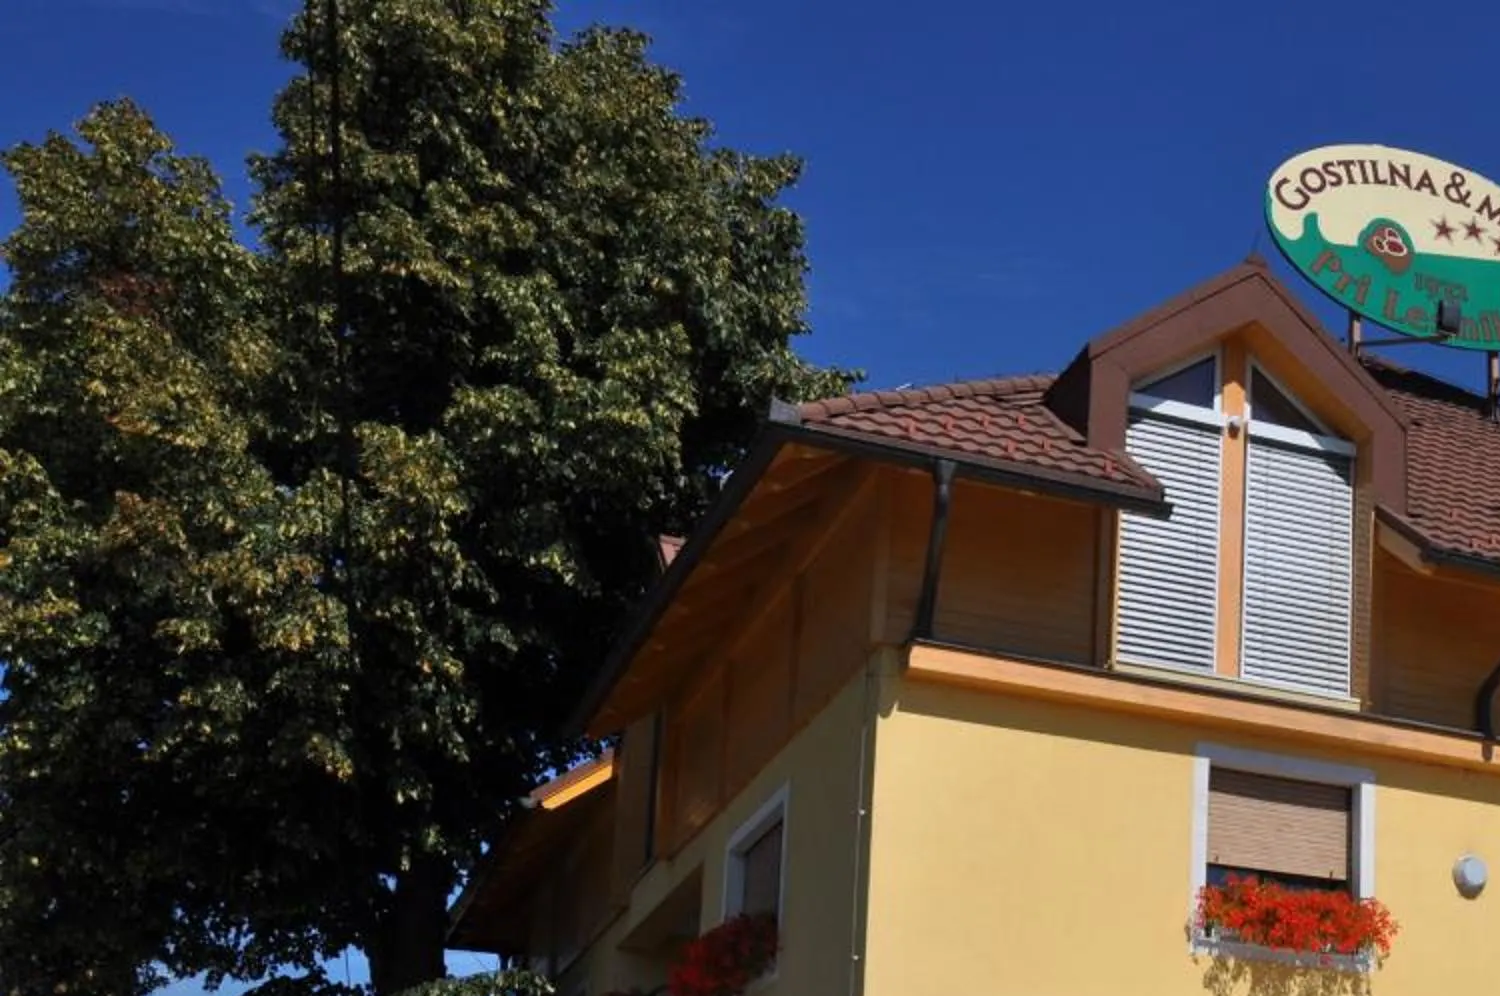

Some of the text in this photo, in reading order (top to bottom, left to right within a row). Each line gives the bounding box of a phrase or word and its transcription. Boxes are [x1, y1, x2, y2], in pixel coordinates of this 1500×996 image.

[1274, 159, 1438, 211] GOSTILNA
[1443, 171, 1472, 208] &
[1311, 249, 1371, 305] Pri
